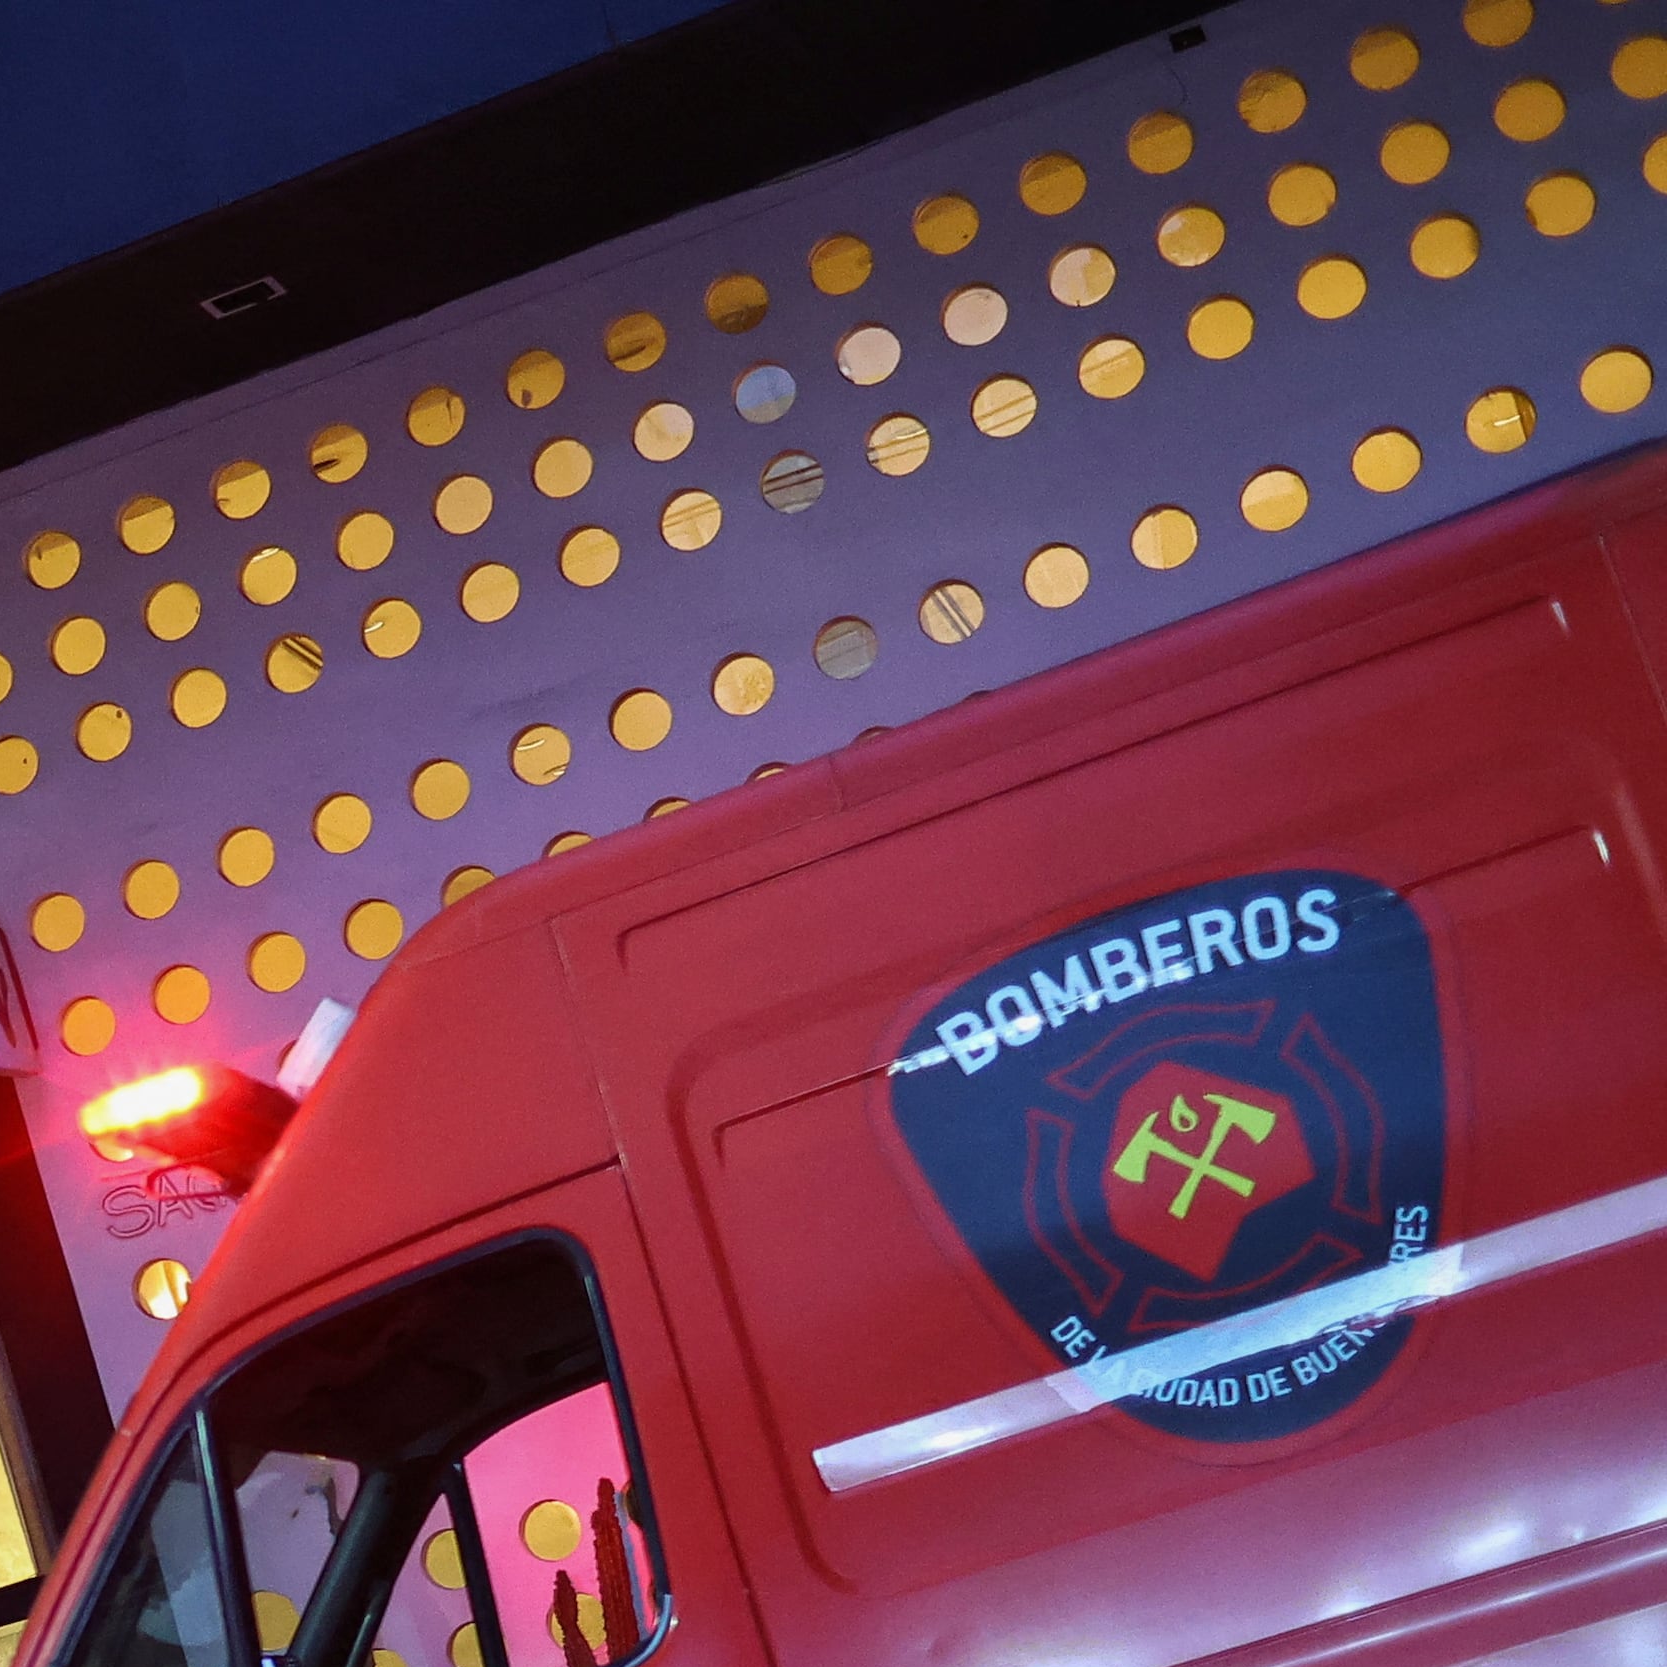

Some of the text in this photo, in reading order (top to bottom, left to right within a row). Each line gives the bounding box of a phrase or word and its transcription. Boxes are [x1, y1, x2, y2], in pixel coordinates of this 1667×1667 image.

[936, 888, 1341, 1076] BOMBEROS
[1051, 1315, 1095, 1359] DE
[1247, 1366, 1292, 1403] DE
[1292, 1326, 1377, 1387] BUEN
